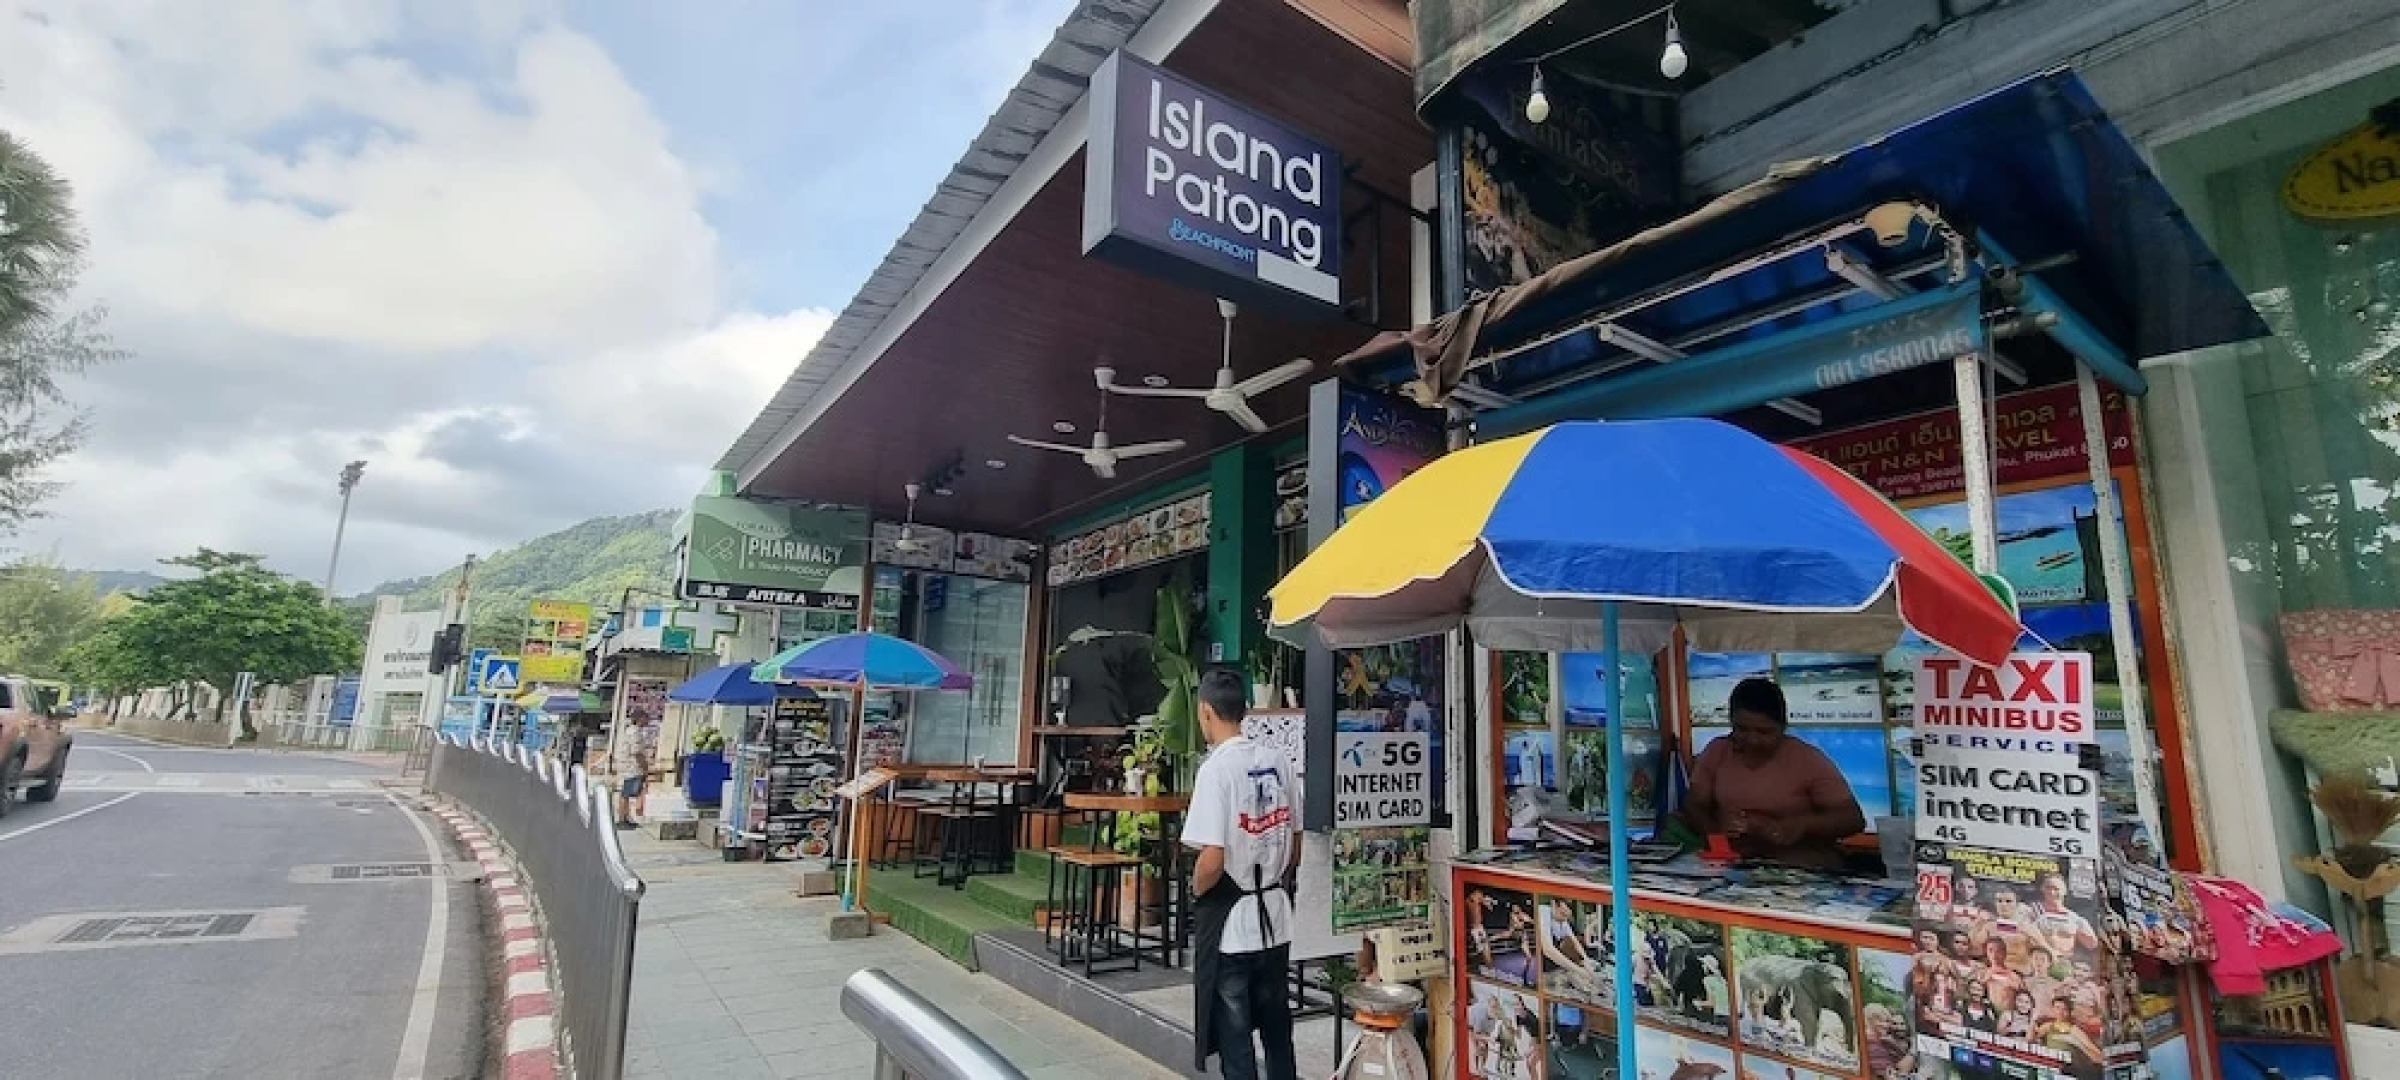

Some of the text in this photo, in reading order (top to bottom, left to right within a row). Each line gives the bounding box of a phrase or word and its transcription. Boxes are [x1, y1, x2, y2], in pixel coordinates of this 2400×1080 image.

[1150, 78, 1321, 207] Island
[1146, 146, 1321, 268] Patong
[2025, 446, 2076, 463] Phuket
[748, 536, 844, 566] PHARMACY
[1922, 659, 2082, 704] TAXI
[1924, 704, 2083, 733] MINIBUS
[1381, 741, 1422, 767] 5G
[1924, 733, 2078, 755] SERVICE
[1337, 772, 1424, 796] INTERNET
[1919, 763, 2089, 796] SIM CARD
[1337, 798, 1425, 822] SIM CARD
[1925, 789, 2091, 834] internet
[1935, 824, 2083, 855] 4G 5G
[1918, 872, 1950, 905] 25
